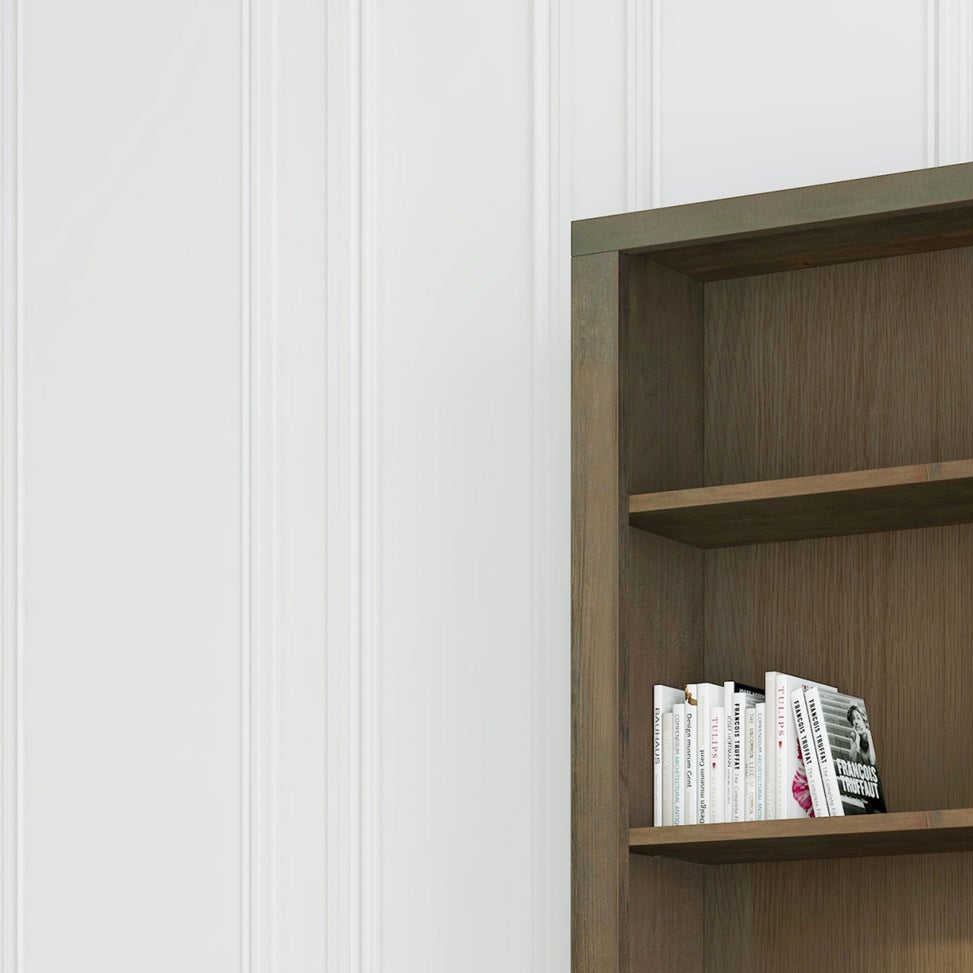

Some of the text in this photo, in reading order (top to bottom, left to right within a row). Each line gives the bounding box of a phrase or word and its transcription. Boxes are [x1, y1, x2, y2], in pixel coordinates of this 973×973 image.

[794, 700, 805, 734] FRANCOIS
[801, 735, 812, 764] TRUFFAT
[809, 699, 820, 733] FRANCOIS
[816, 734, 827, 763] TRUFFAT
[836, 758, 878, 782] FRANCOIS
[842, 775, 880, 799] TRUFFAUT
